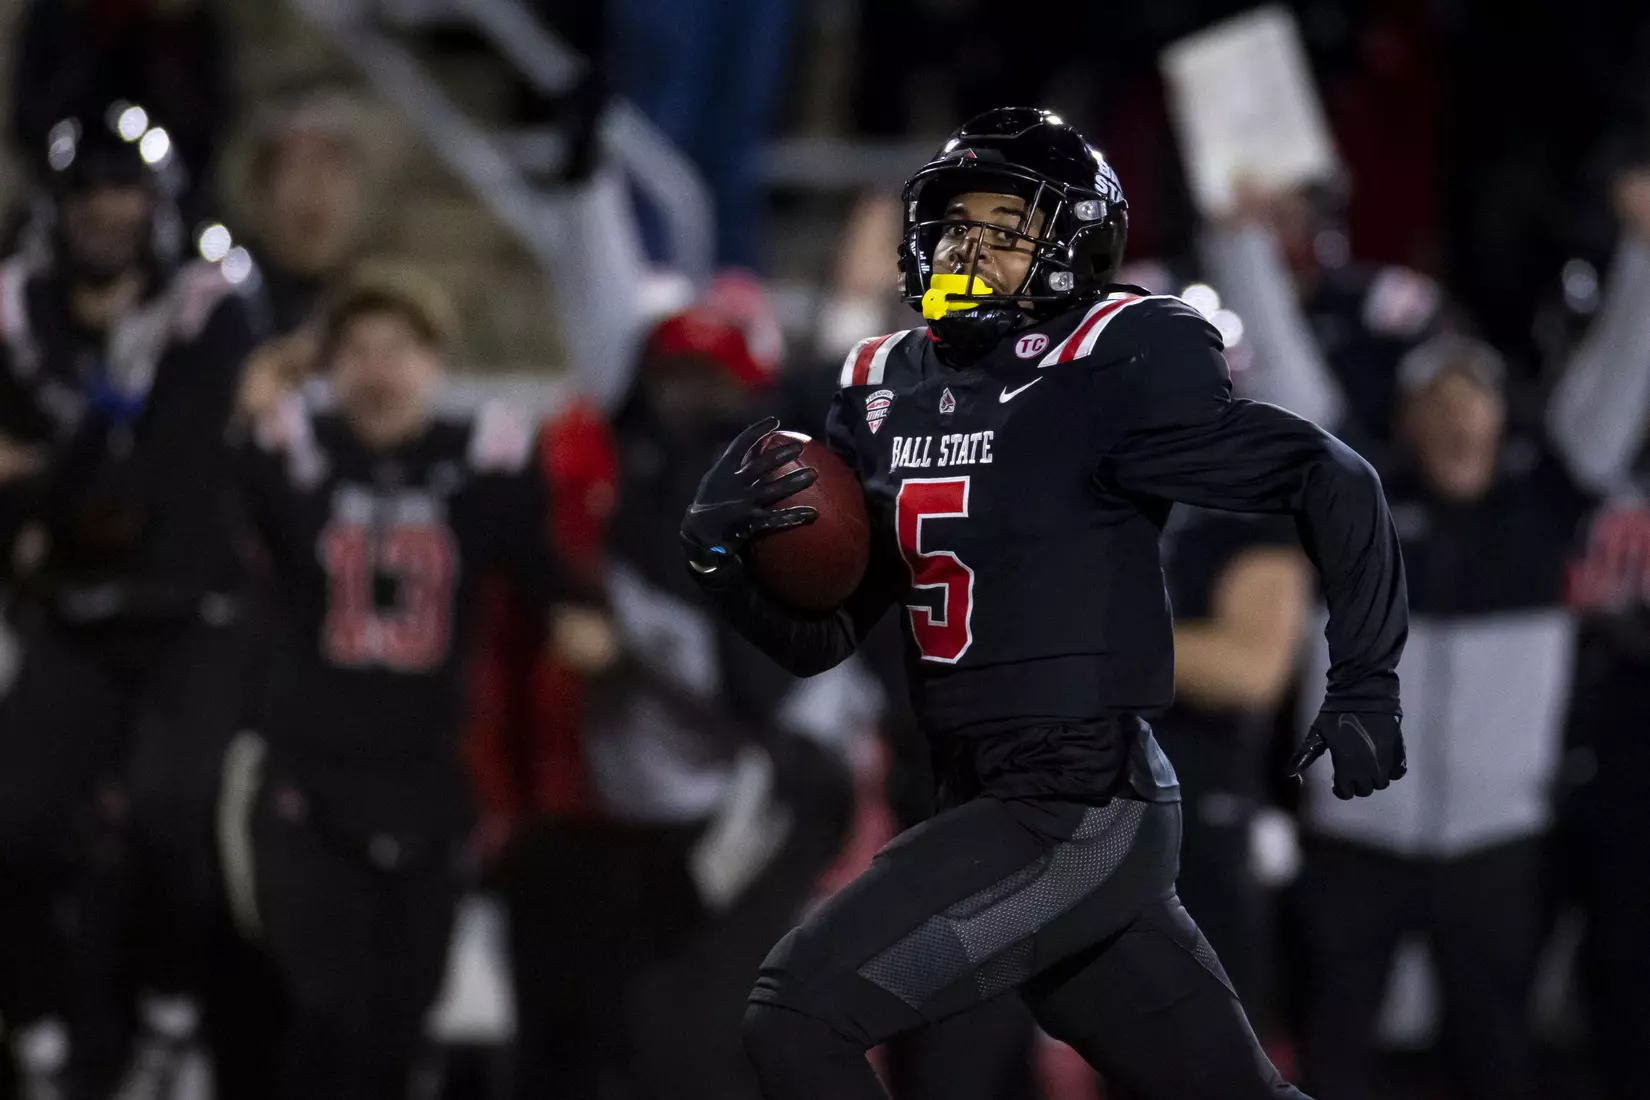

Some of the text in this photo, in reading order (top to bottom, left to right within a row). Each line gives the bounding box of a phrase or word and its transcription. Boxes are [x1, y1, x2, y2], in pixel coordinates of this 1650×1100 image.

[1021, 338, 1045, 354] TC
[889, 430, 994, 470] BALL STATE
[895, 475, 975, 664] 5
